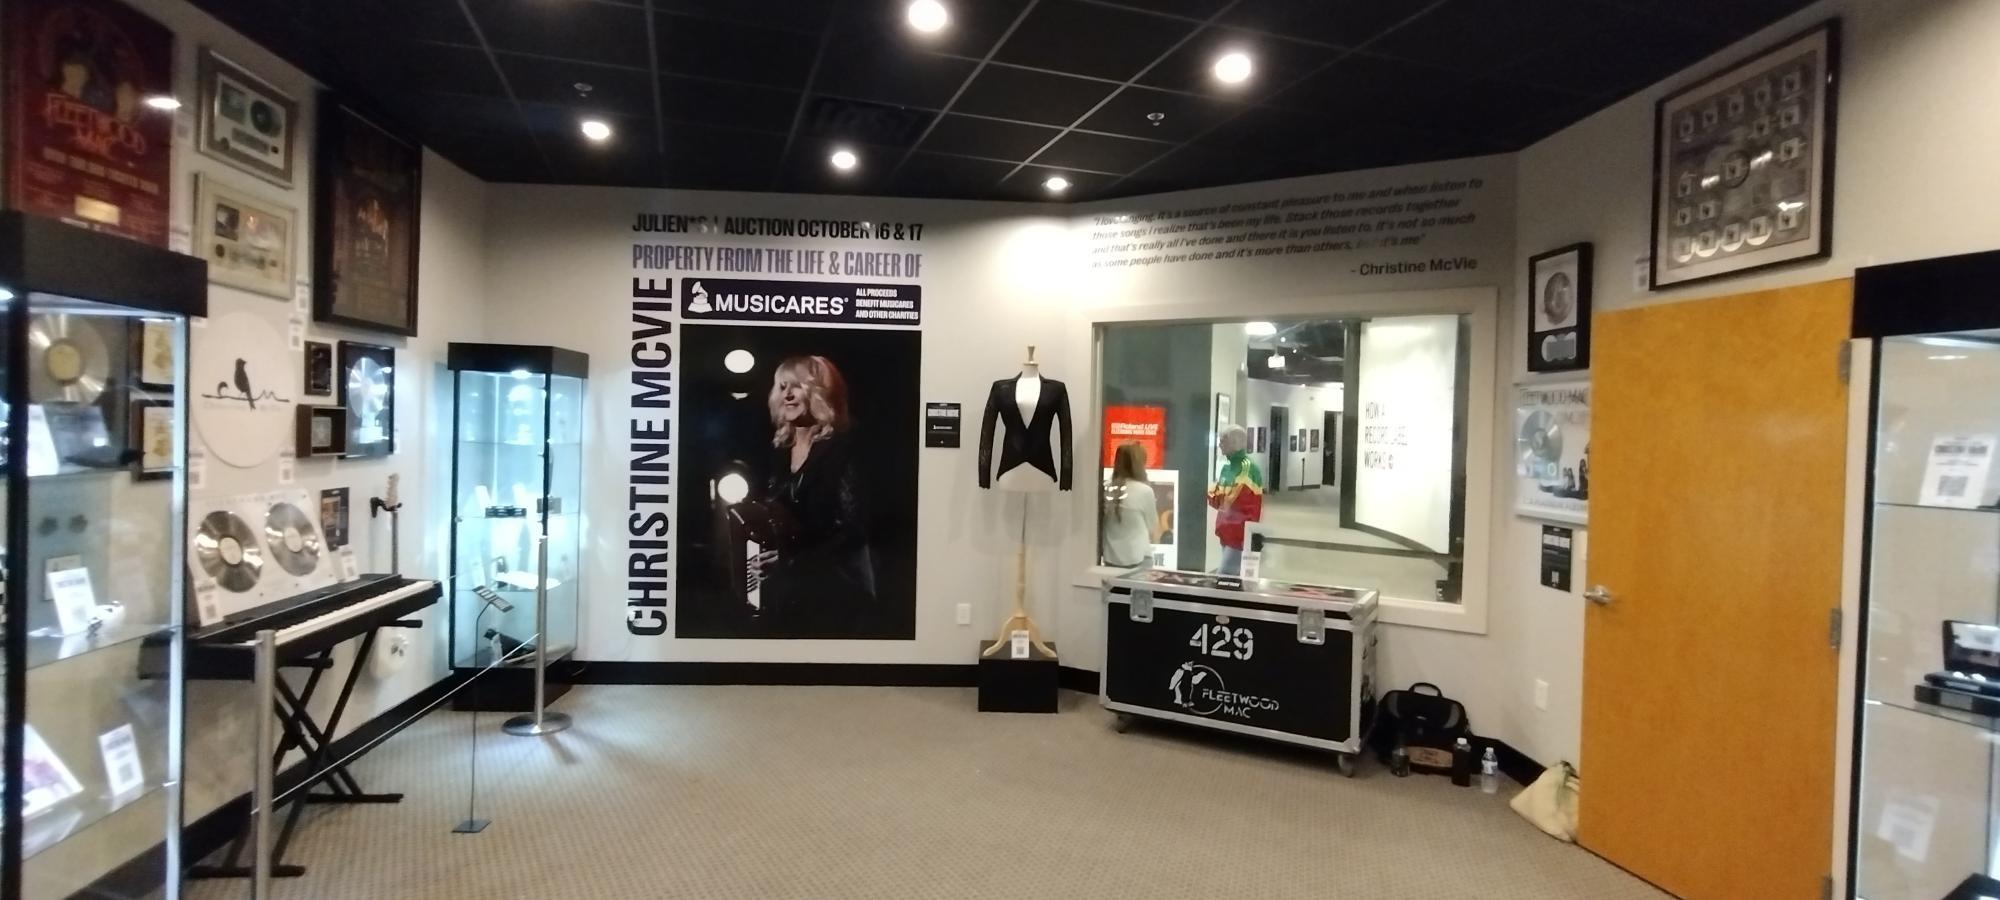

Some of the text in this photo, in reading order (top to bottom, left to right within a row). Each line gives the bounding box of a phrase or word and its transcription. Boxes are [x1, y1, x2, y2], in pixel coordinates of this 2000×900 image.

[1183, 207, 1217, 217] source
[1231, 199, 1280, 213] constant
[1280, 194, 1331, 209] pleasure
[1333, 192, 1345, 201] to
[1347, 191, 1366, 200] me
[1368, 187, 1392, 198] and
[724, 217, 794, 236] AUCTION
[797, 219, 869, 239] OCTOBER
[873, 222, 890, 240] 16
[893, 222, 905, 240] &
[908, 223, 924, 241] 17
[1120, 229, 1146, 239] songs
[1154, 224, 1185, 234] realize
[1217, 219, 1244, 229] been
[1286, 212, 1319, 222] Stack
[1321, 209, 1353, 219] those
[1356, 203, 1403, 216] records
[1405, 199, 1460, 213] together
[1139, 241, 1165, 251] really
[1167, 239, 1178, 247] all
[1199, 236, 1225, 246] done
[1226, 233, 1247, 243] and
[1248, 231, 1277, 241] there
[1279, 229, 1287, 238] it
[1300, 228, 1321, 239] you
[1323, 224, 1356, 235] listen
[1398, 218, 1418, 229] not
[632, 244, 922, 278] PROPERTY FROM THE LIFE & CAREER OF
[1104, 259, 1128, 267] some
[1129, 256, 1164, 267] people
[1164, 254, 1187, 262] have
[1188, 251, 1214, 261] done
[1215, 249, 1236, 259] and
[1237, 248, 1253, 257] it's
[1255, 246, 1283, 256] more
[1285, 244, 1311, 254] than
[1359, 261, 1426, 276] Christine
[1430, 257, 1478, 271] McVie
[856, 288, 898, 297] ALL PROCEEDS
[856, 299, 914, 309] BENEFIT MUSICARES
[856, 309, 919, 320] AND OTHER CHARITIES
[626, 277, 673, 637] CHRISTINE MCVIE
[1190, 623, 1254, 660] 429
[1202, 688, 1280, 711] FLEETWOOD
[1223, 705, 1251, 719] MAC
